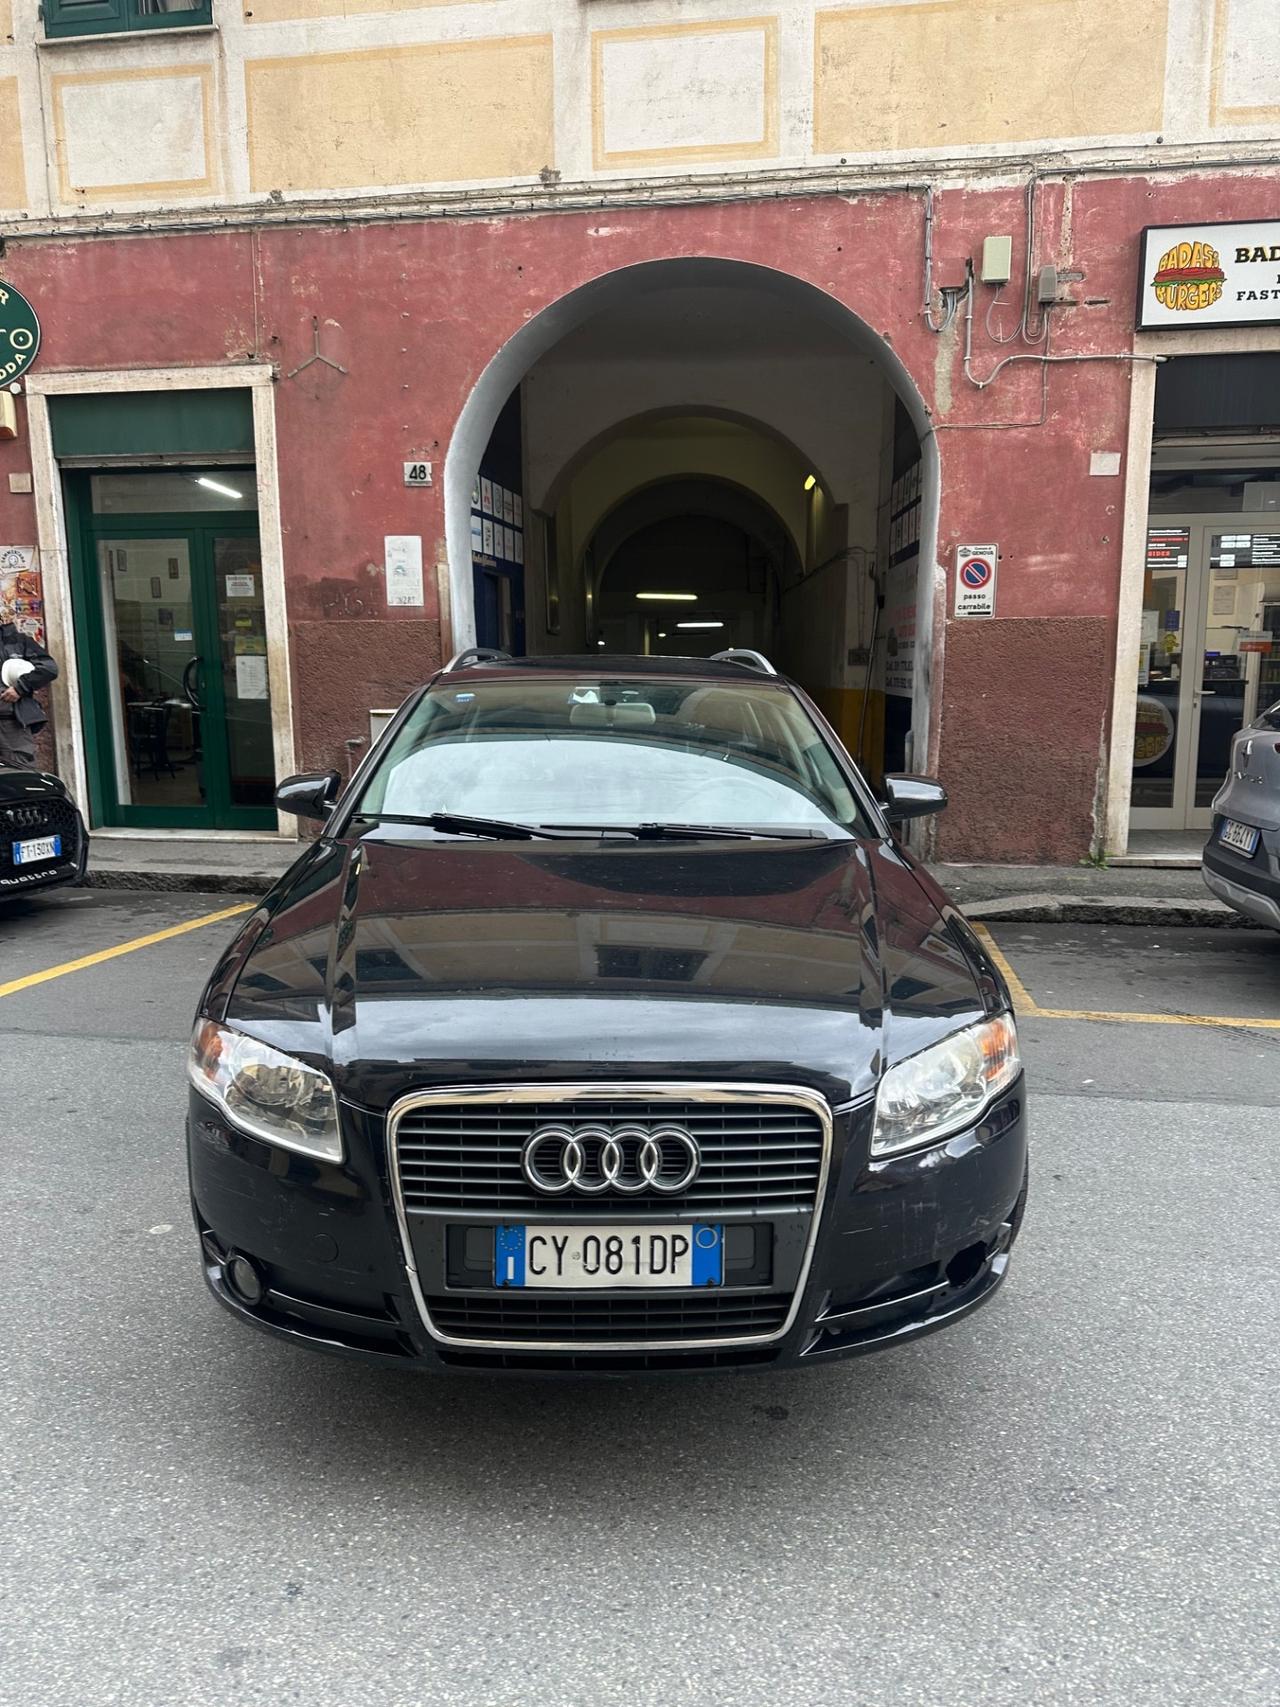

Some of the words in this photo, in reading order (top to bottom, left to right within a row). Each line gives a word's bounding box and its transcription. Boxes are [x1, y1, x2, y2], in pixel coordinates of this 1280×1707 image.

[1155, 283, 1223, 311] BURGERS
[409, 464, 427, 480] 48
[0, 869, 58, 885] quattro
[528, 1235, 569, 1276] CY
[582, 1234, 689, 1275] 081DP
